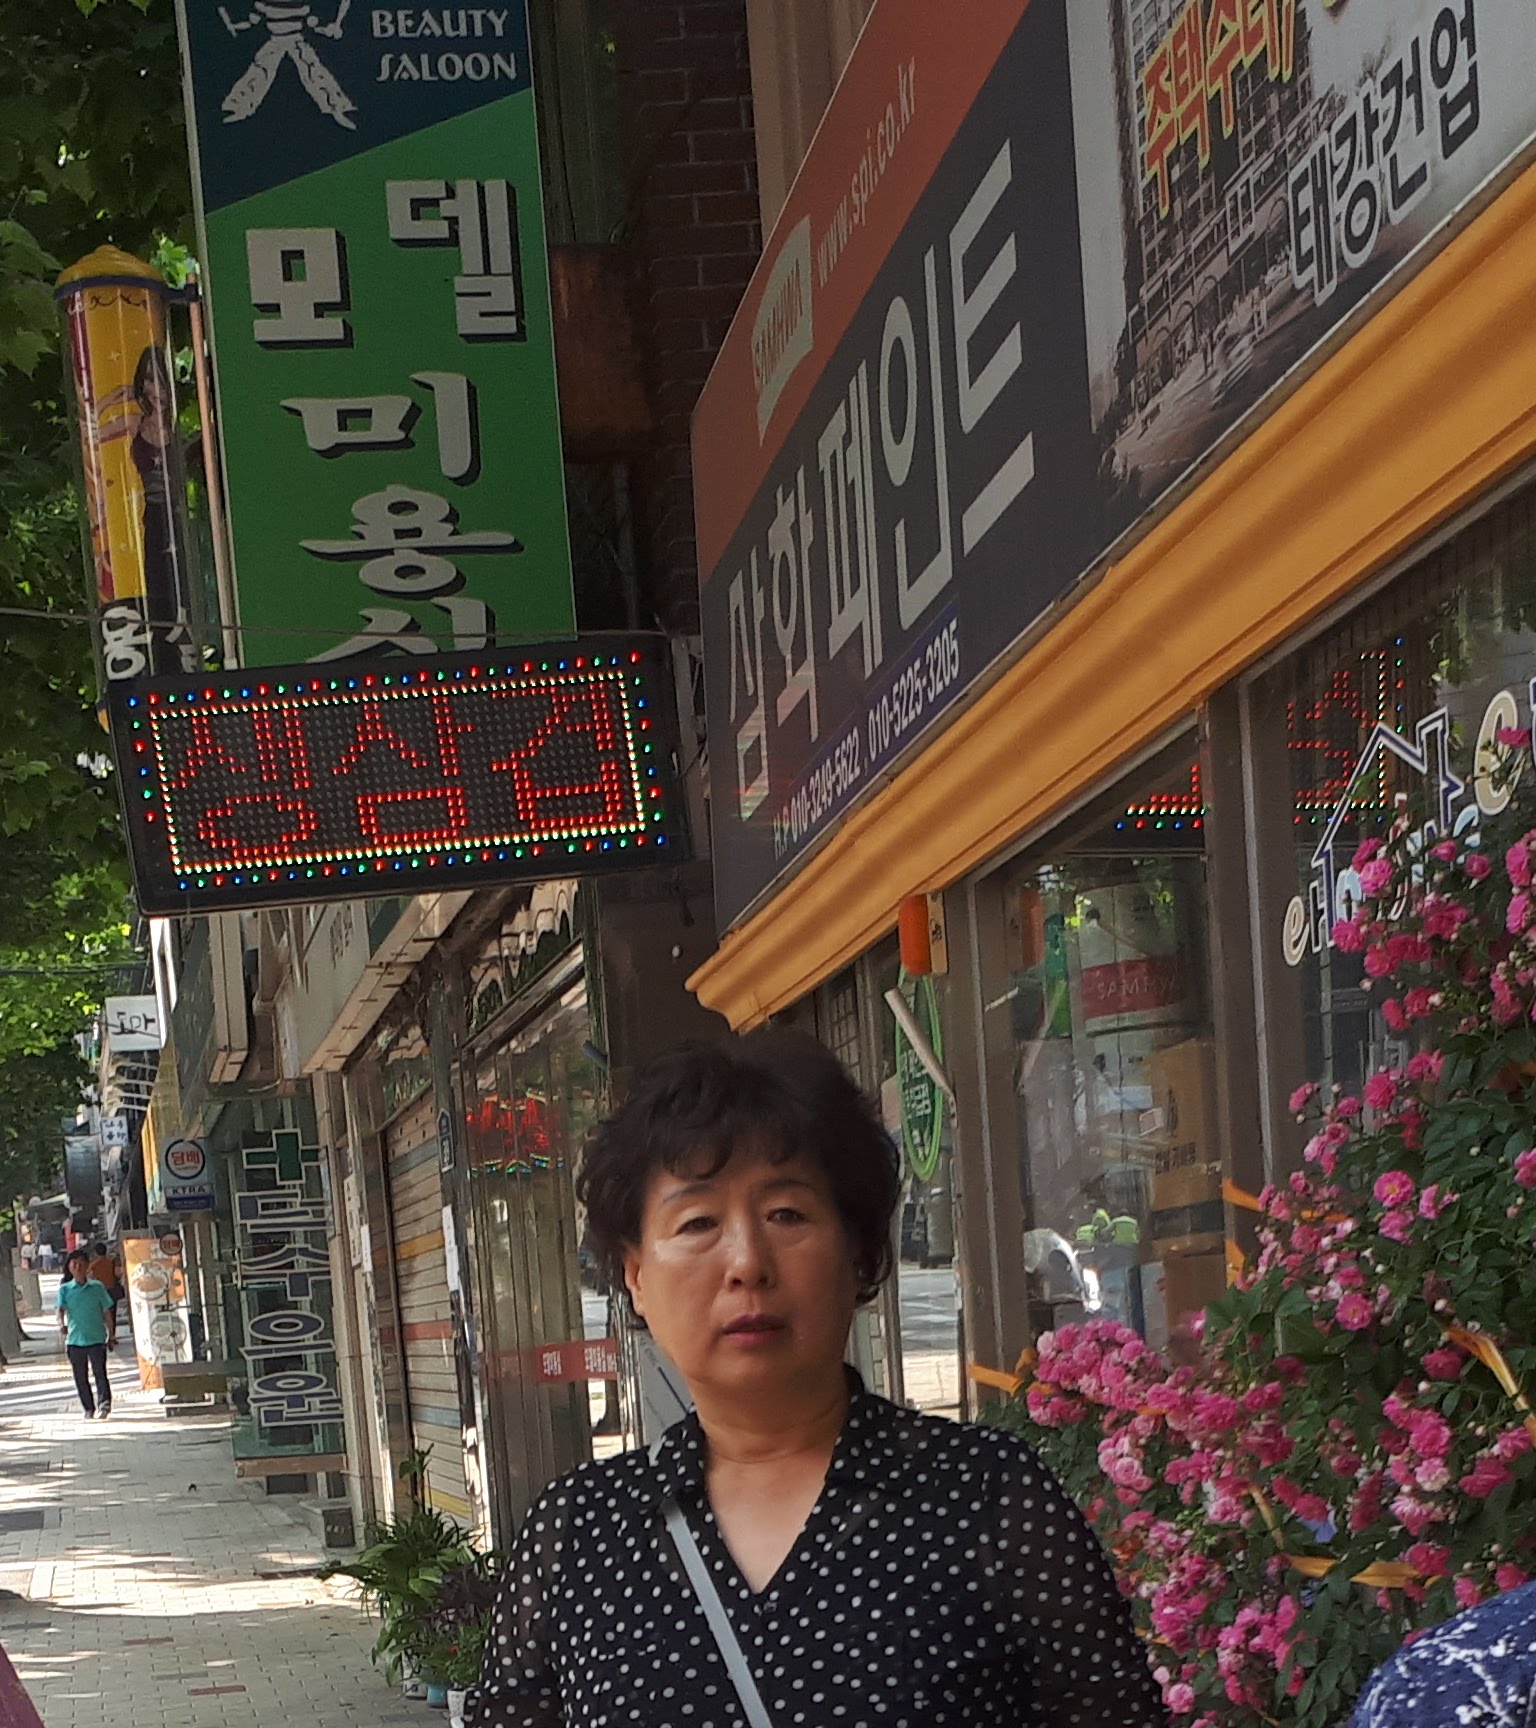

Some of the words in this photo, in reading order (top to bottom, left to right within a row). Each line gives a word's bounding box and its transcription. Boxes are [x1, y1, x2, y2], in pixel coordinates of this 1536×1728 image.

[371, 8, 507, 40] BEAUTY
[376, 53, 519, 82] SALOON
[817, 56, 915, 288] www.spi.co.kr
[1287, 0, 1481, 306] 태강건업
[245, 178, 519, 342] 모델
[728, 138, 1036, 820] 삼화페인트
[868, 618, 961, 763] 010-5225-3205
